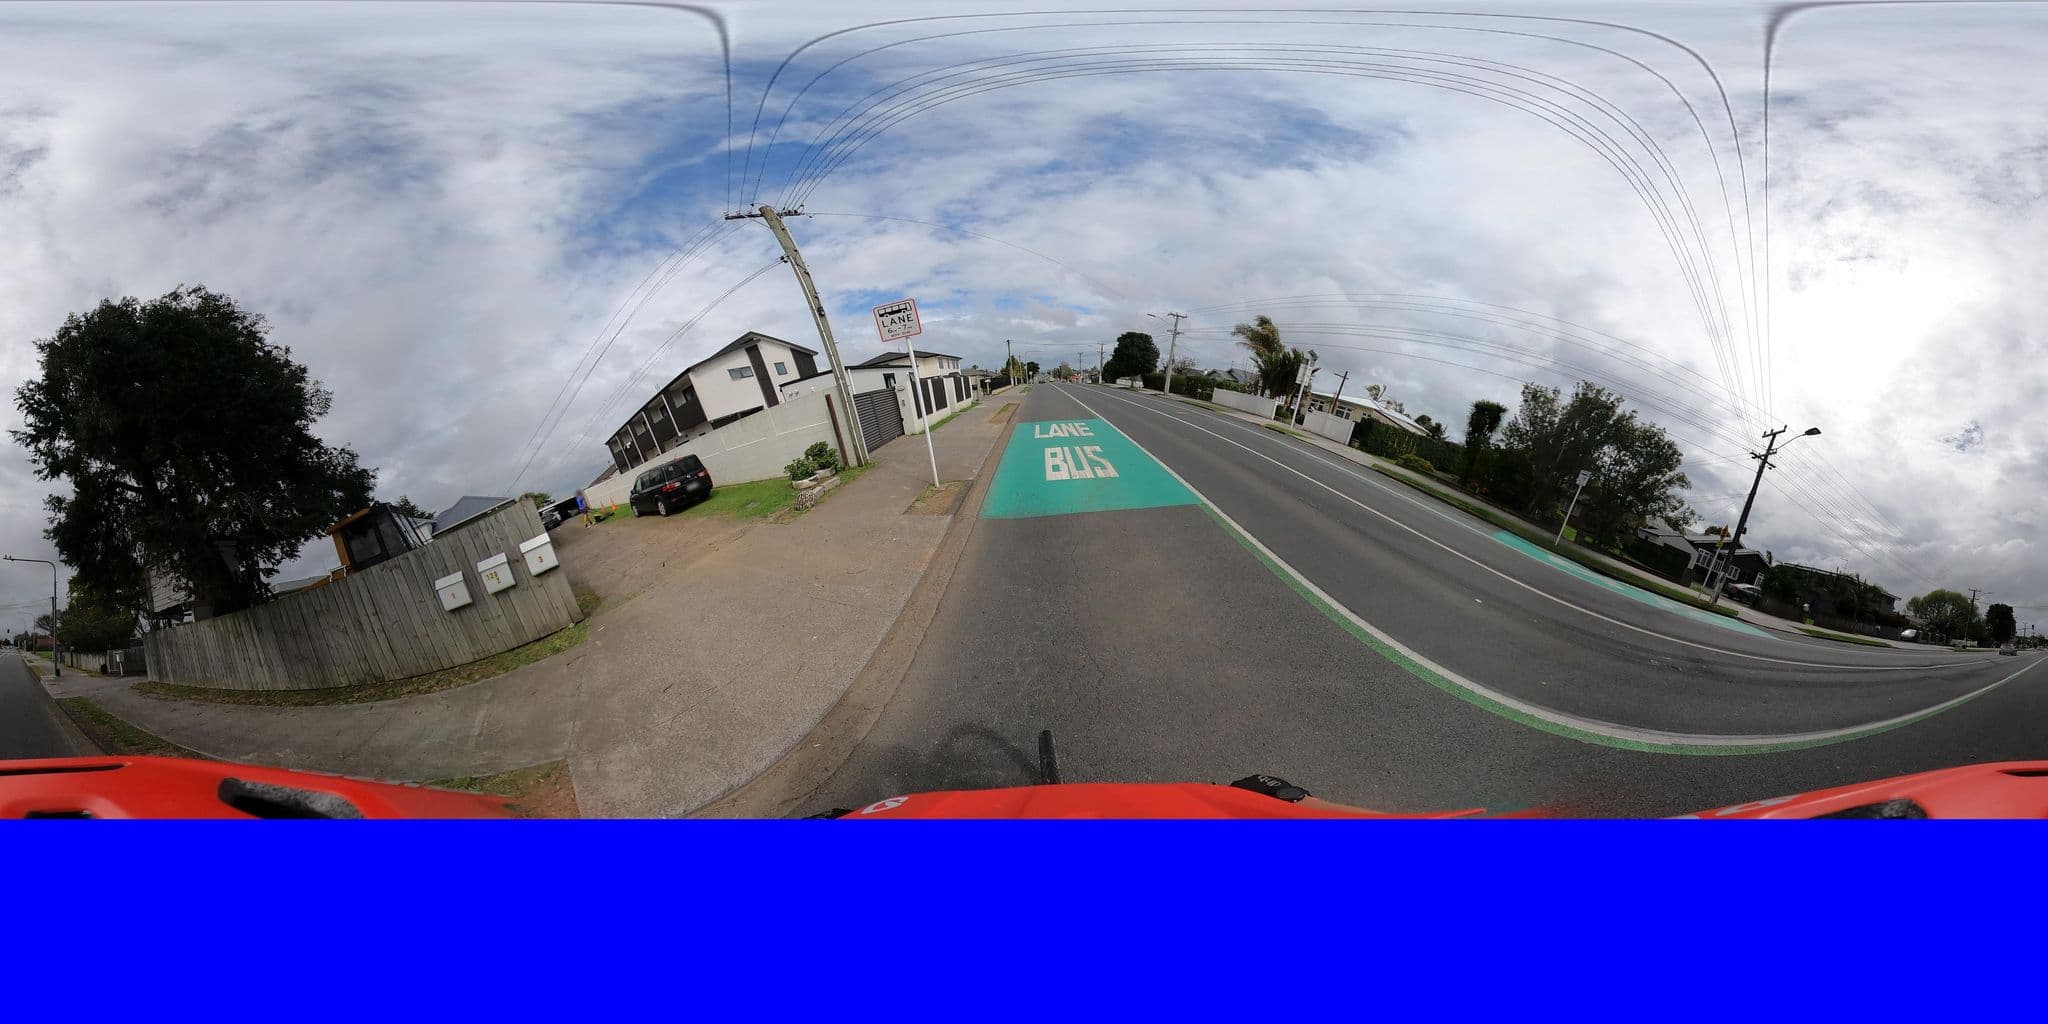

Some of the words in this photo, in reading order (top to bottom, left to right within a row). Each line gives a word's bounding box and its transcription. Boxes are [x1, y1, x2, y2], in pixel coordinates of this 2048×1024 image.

[882, 313, 913, 327] LANE
[1034, 422, 1095, 439] LANE
[1044, 445, 1120, 481] BUS
